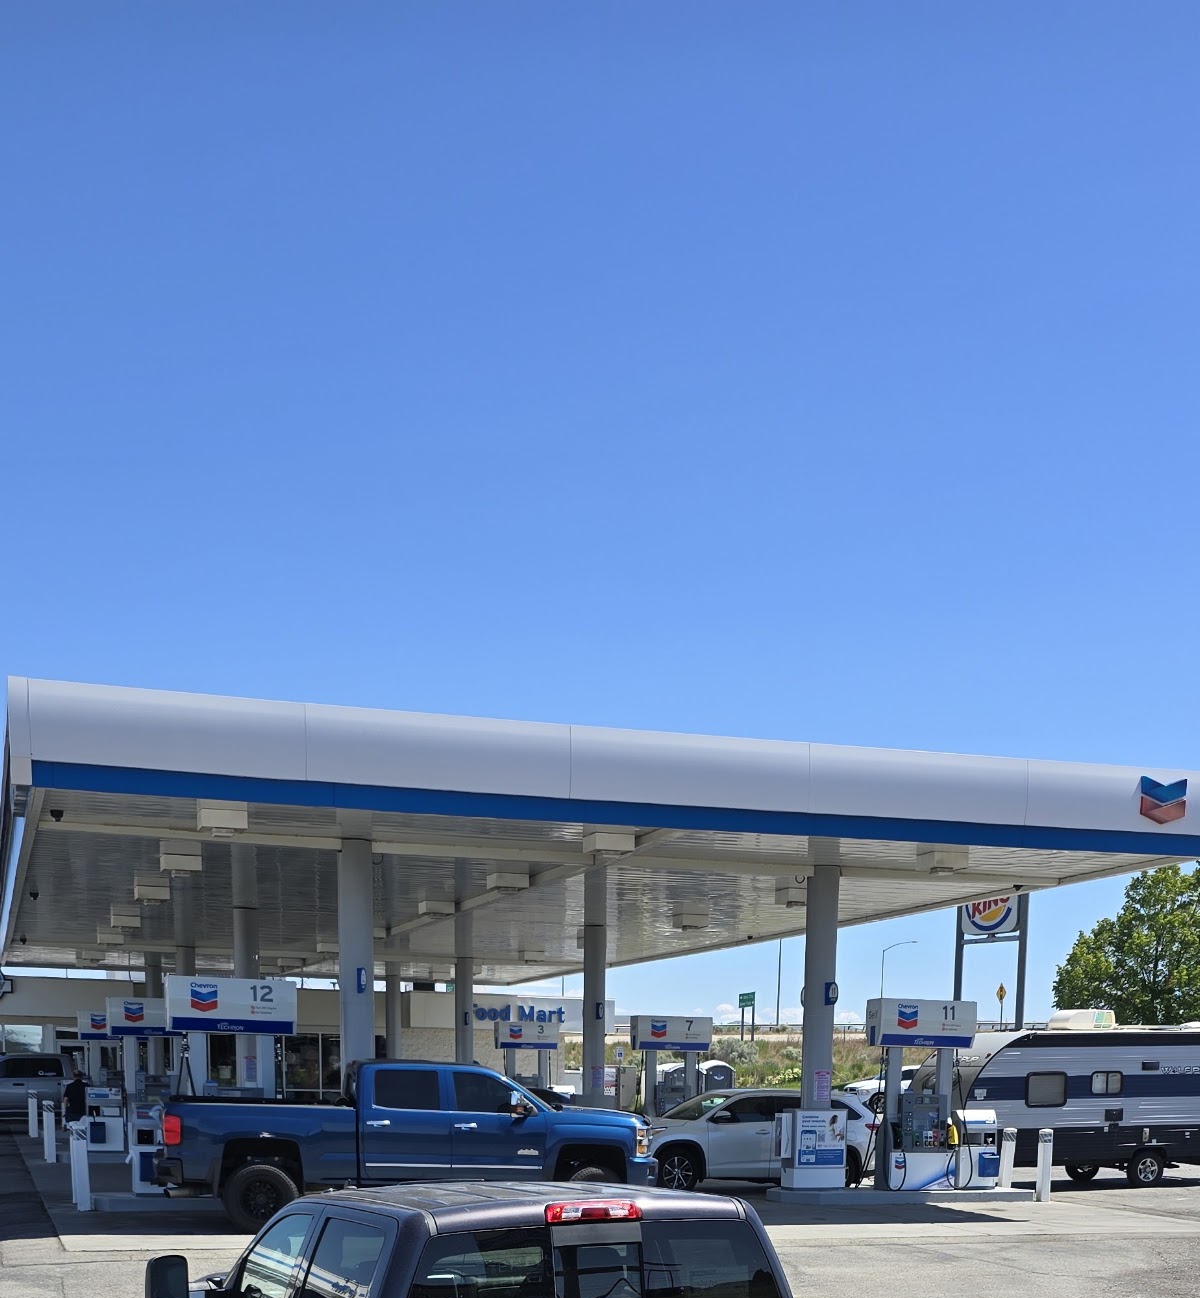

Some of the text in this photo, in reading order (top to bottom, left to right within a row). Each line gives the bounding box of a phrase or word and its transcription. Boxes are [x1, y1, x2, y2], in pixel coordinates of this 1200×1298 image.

[250, 985, 273, 1002] 12
[518, 1005, 565, 1023] Mart
[942, 1006, 955, 1020] 11
[537, 1025, 544, 1034] 3
[686, 1020, 694, 1032] 7
